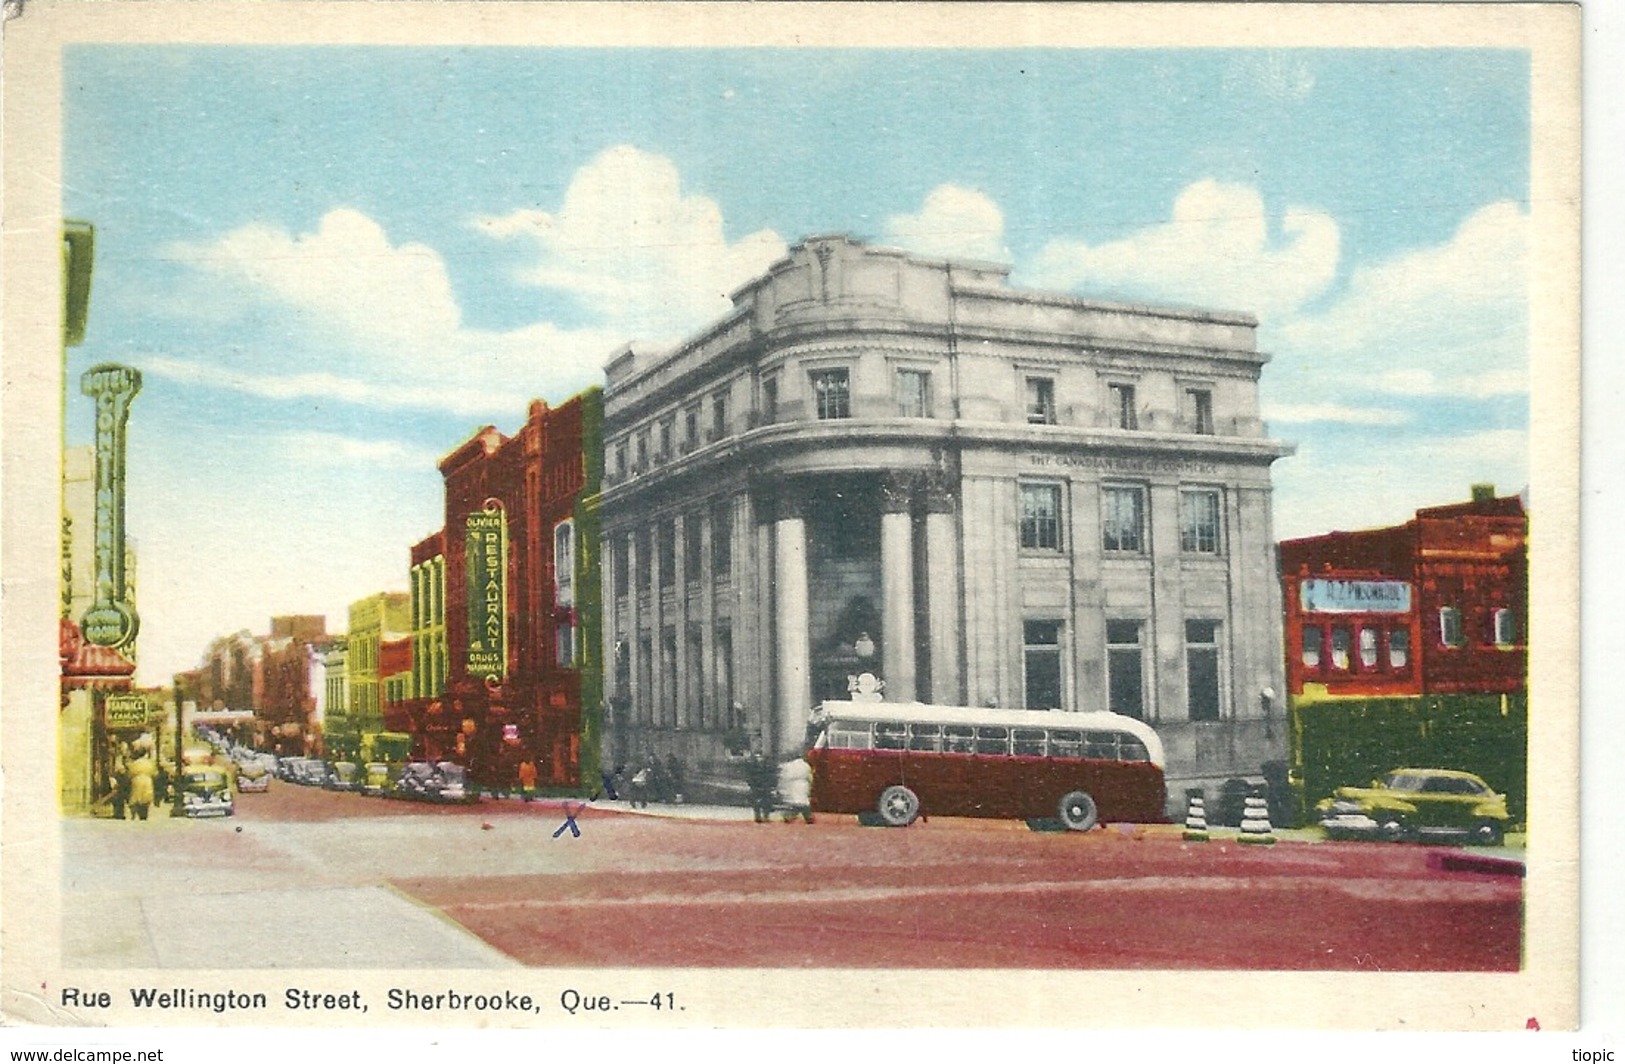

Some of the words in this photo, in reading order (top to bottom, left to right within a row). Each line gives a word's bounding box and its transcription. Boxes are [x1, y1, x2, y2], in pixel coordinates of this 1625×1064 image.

[1056, 455, 1113, 469] CANADIAN
[1163, 461, 1217, 474] COMMERCE
[466, 517, 500, 527] OLIVIER
[485, 532, 500, 648] RESTAURANT
[470, 653, 499, 661] DRUGS
[61, 988, 112, 1008] Rue
[130, 988, 267, 1012] Wellington
[284, 988, 368, 1013] Street,
[387, 988, 541, 1013] Sherbrooke,
